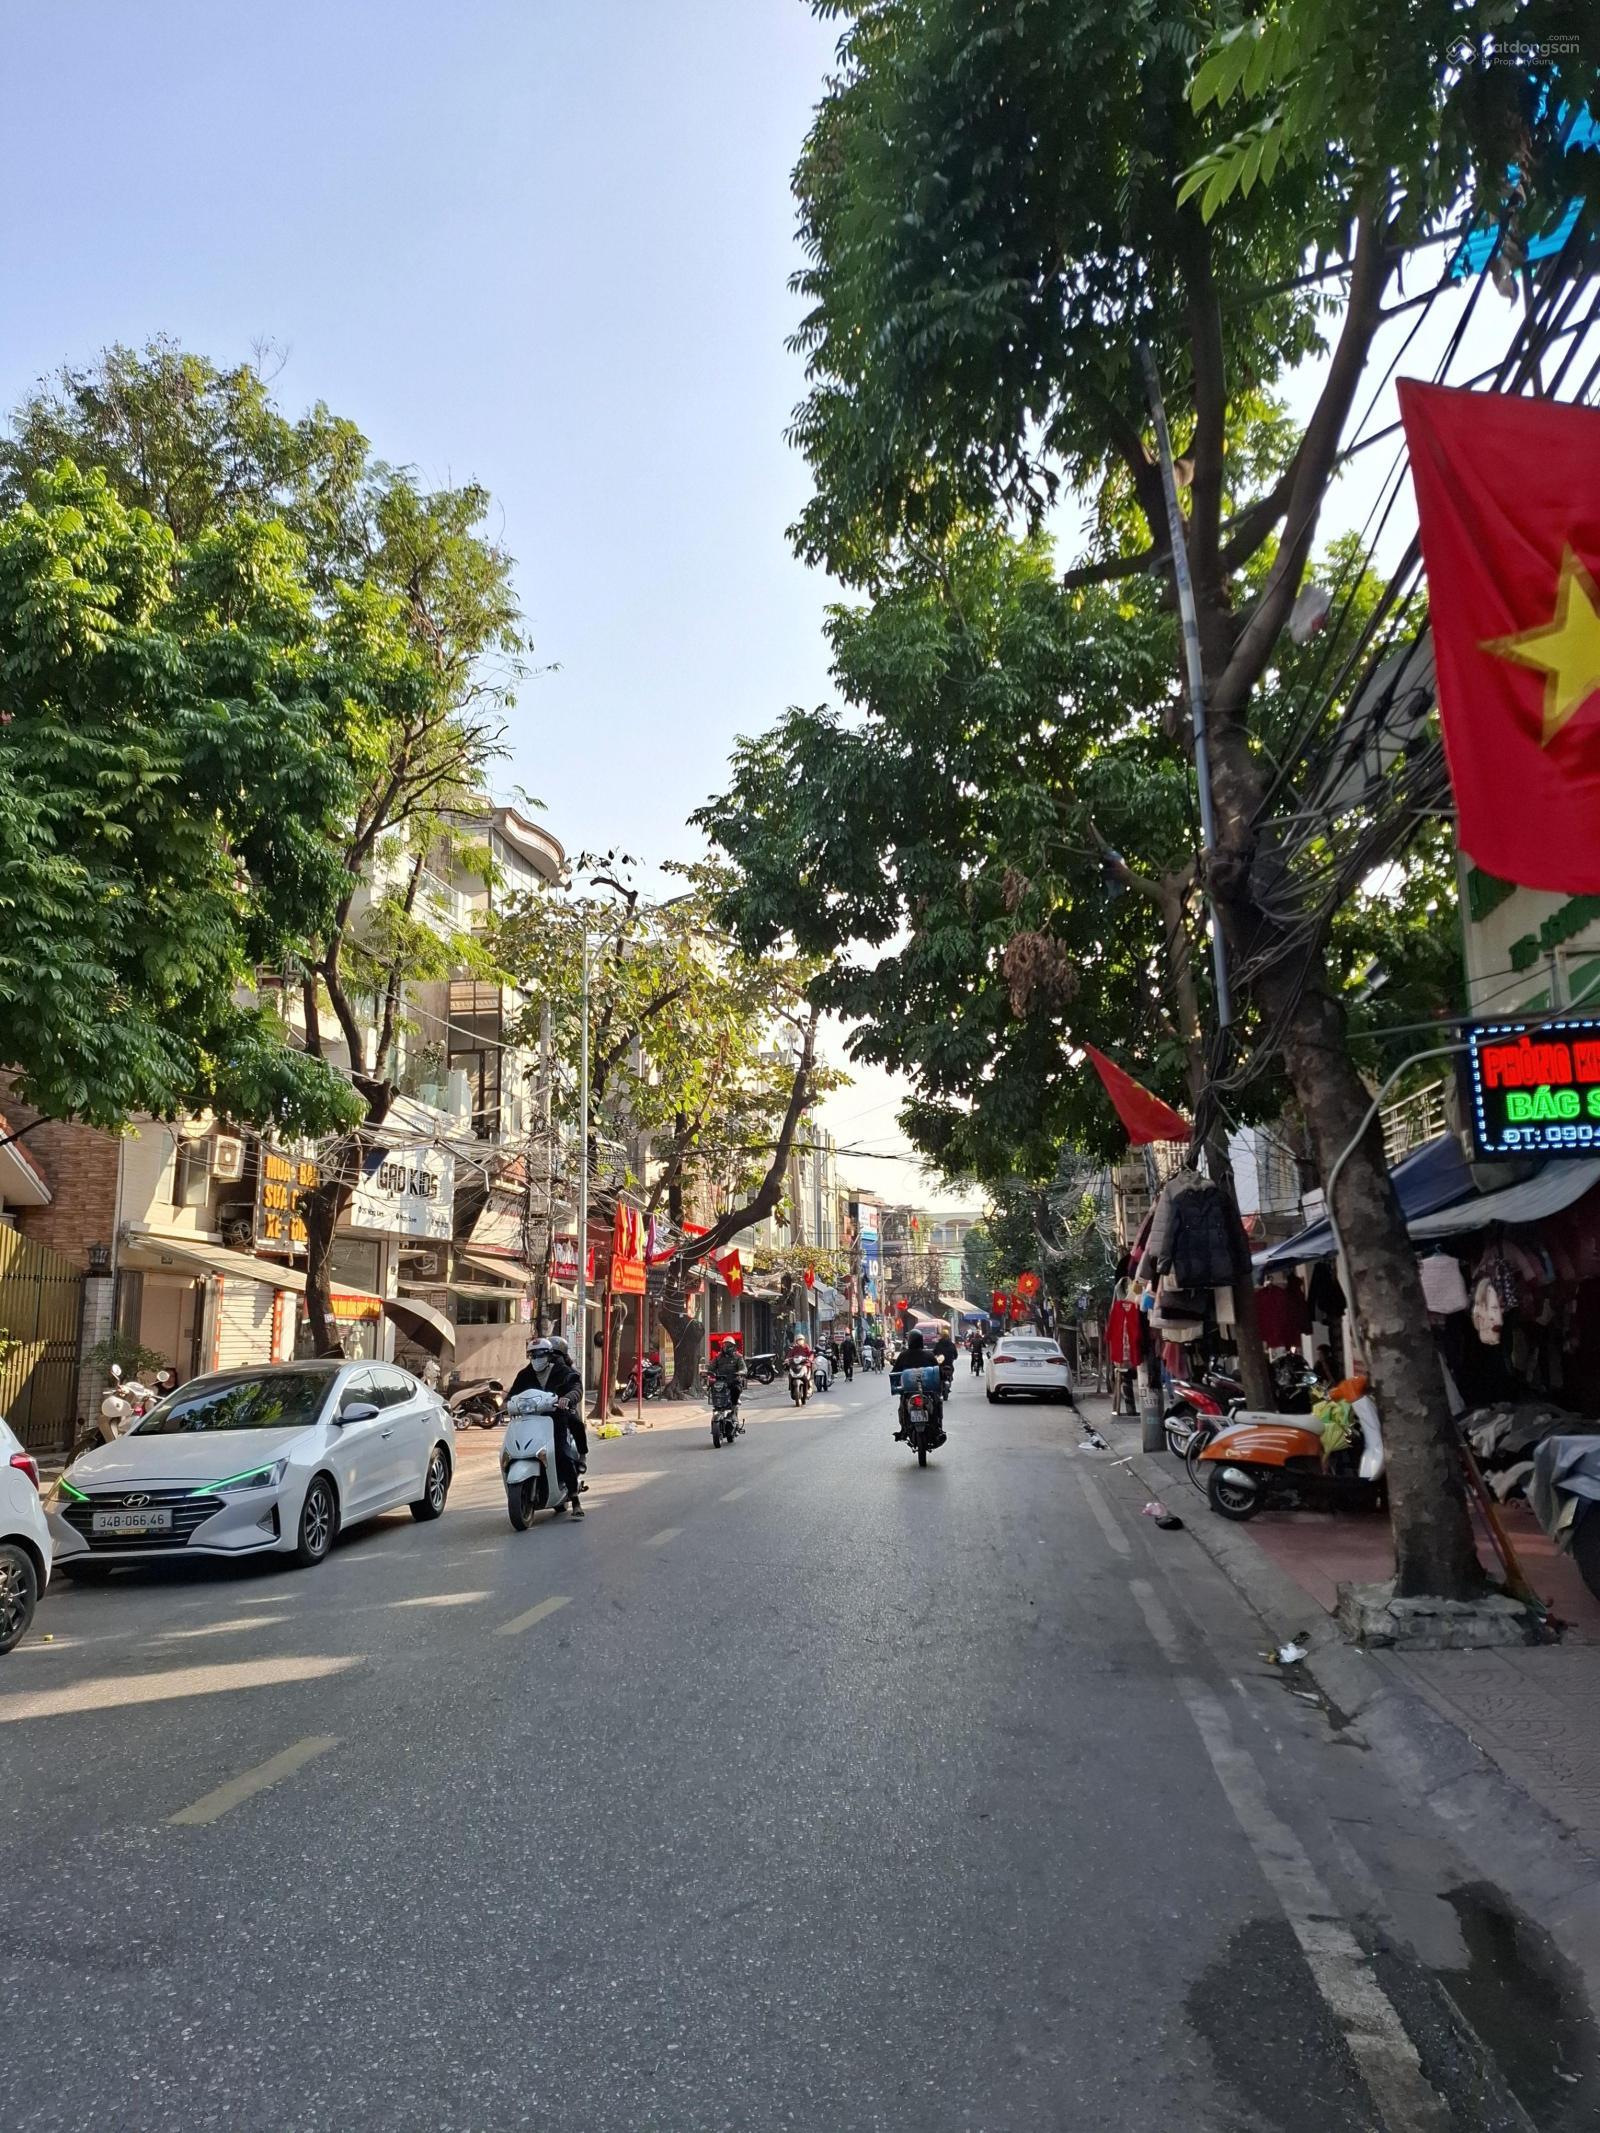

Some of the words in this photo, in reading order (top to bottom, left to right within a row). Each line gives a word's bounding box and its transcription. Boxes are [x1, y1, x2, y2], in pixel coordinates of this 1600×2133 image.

[1506, 1084, 1580, 1121] BÁC
[408, 1168, 438, 1199] KIDS
[99, 1514, 165, 1529] 34B-066.46
